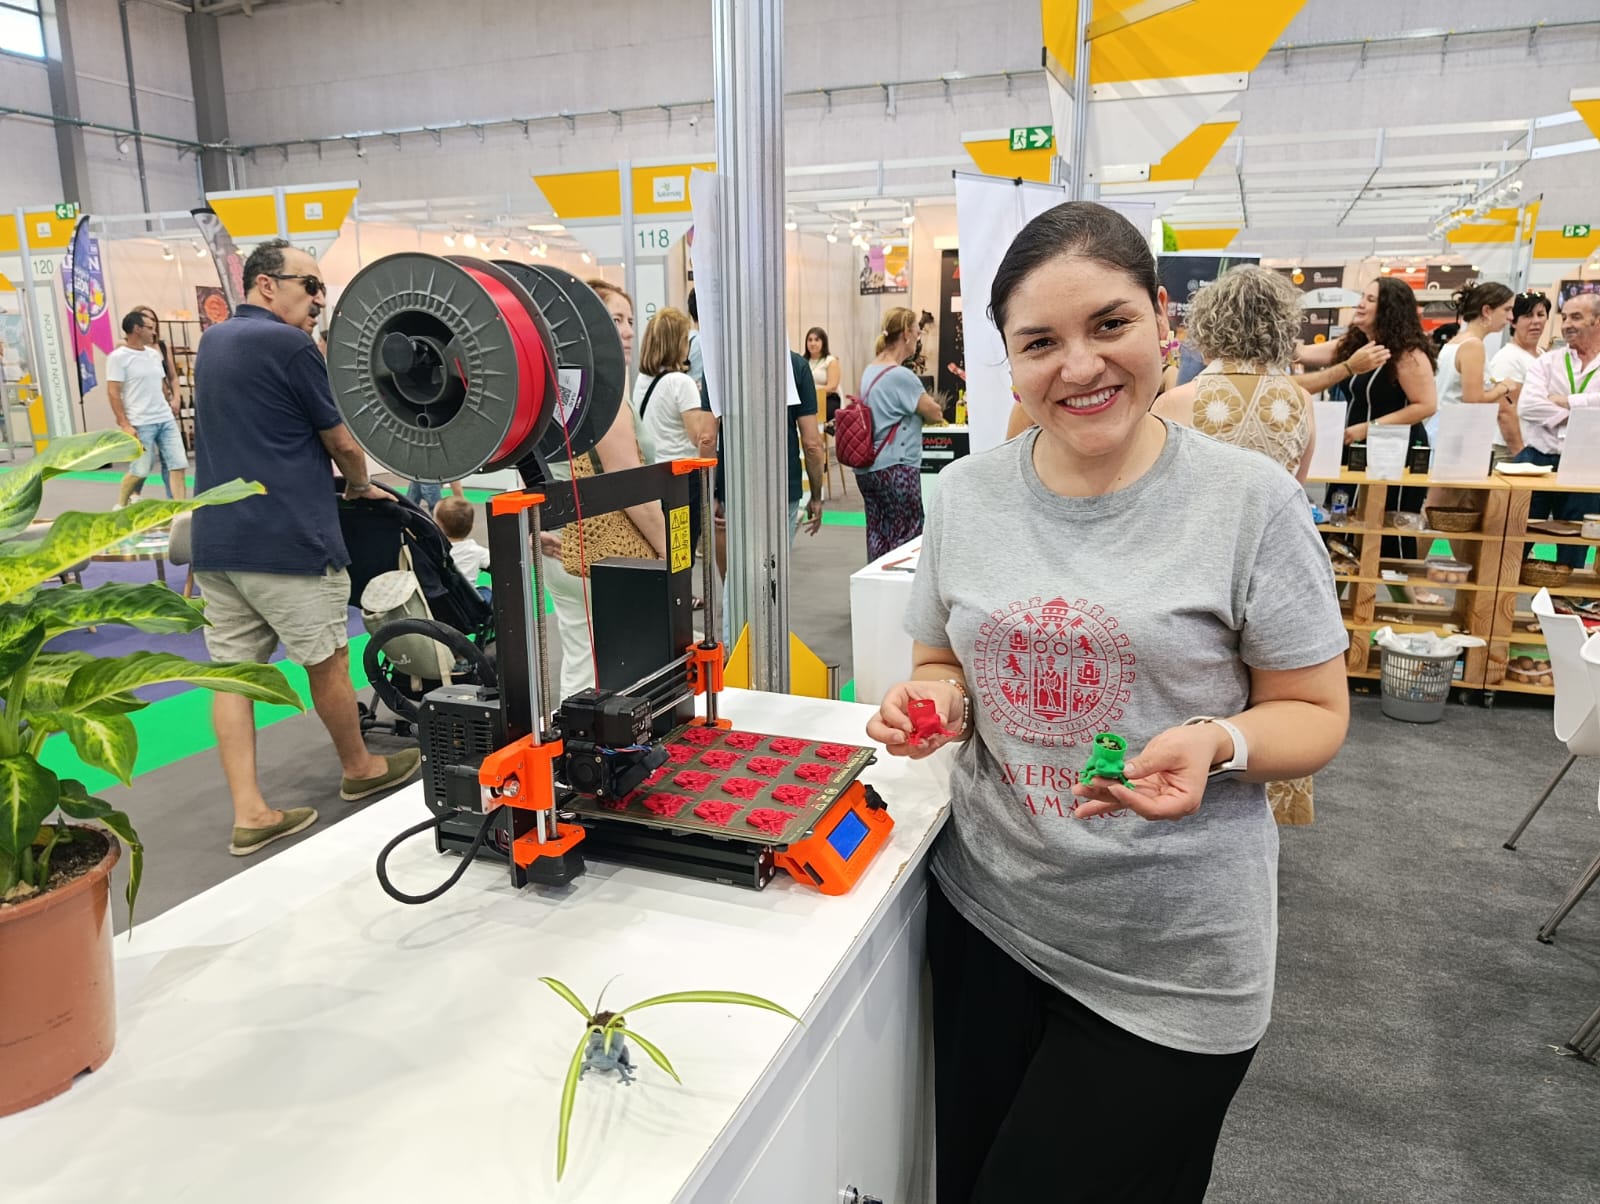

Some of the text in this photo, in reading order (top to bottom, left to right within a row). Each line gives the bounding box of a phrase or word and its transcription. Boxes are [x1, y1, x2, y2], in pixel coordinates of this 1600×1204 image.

[638, 228, 670, 249] 118
[33, 259, 54, 275] 120
[49, 349, 57, 365] DE
